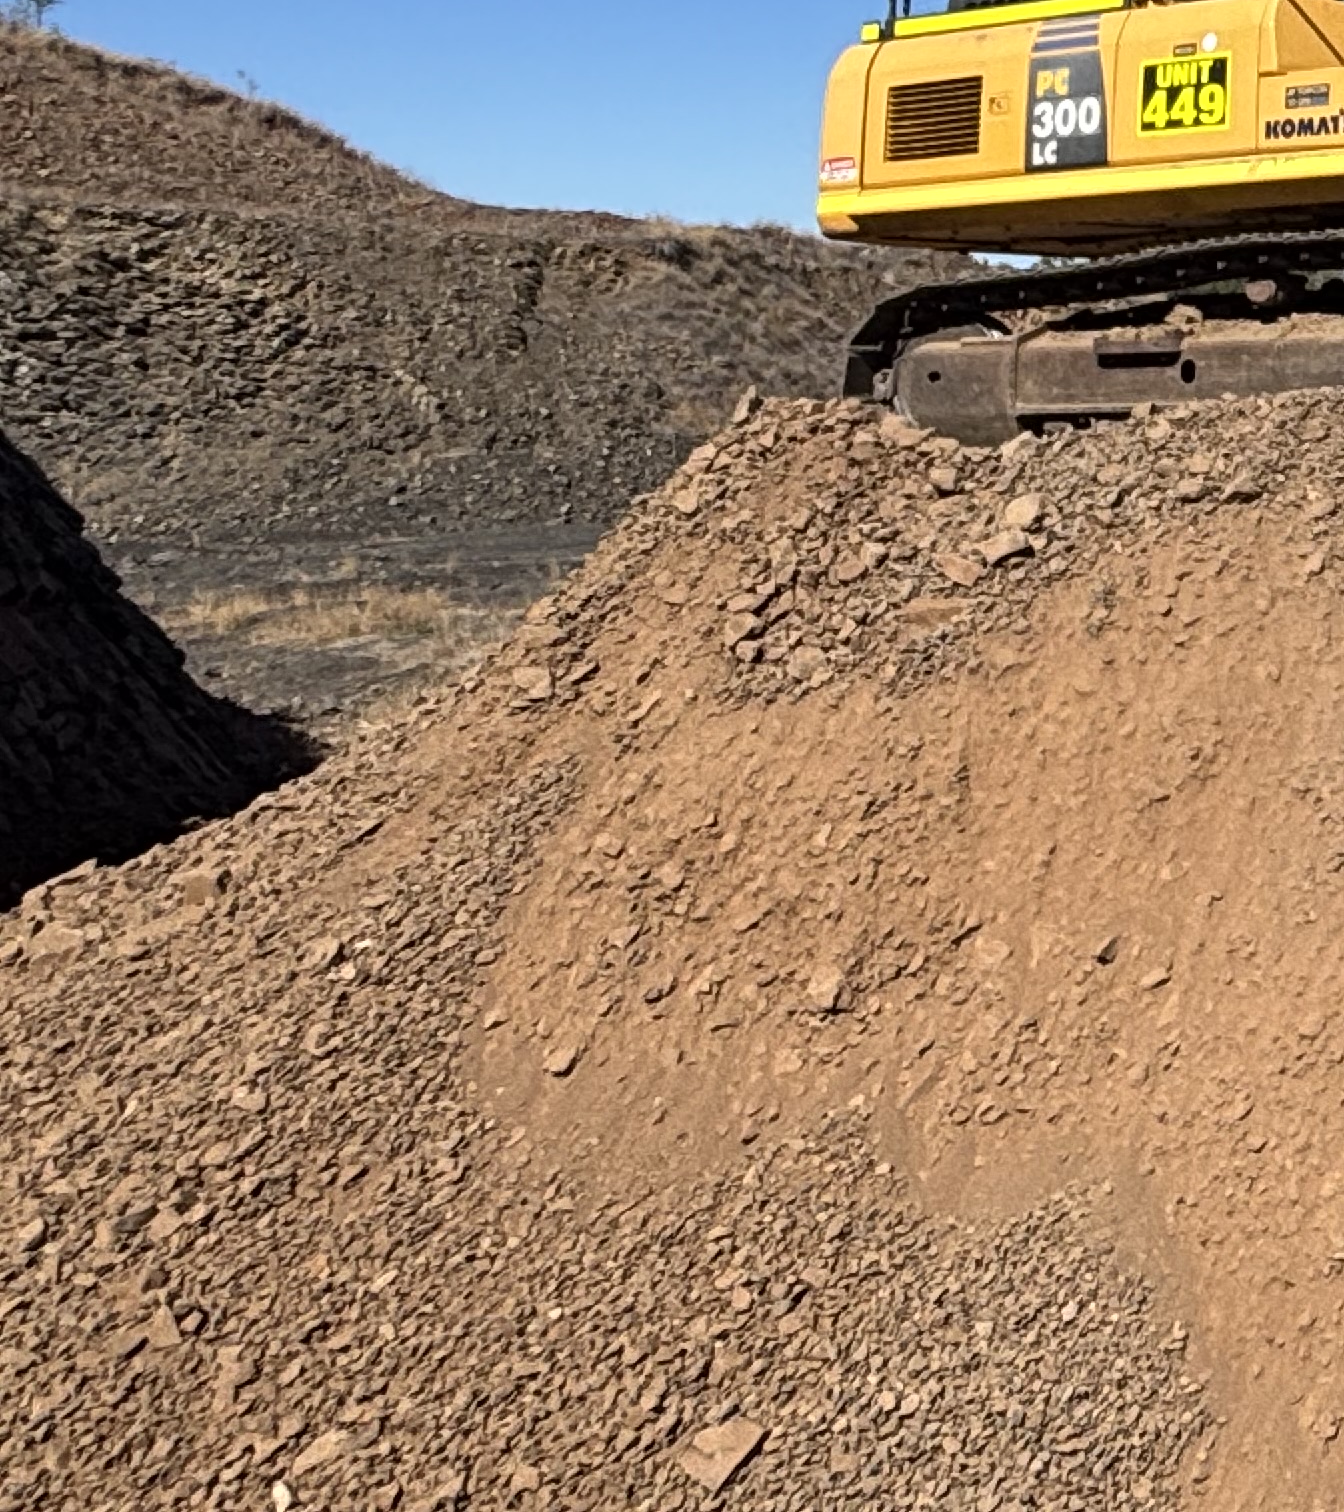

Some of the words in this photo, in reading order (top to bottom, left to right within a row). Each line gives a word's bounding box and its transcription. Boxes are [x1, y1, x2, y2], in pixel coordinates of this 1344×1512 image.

[1036, 67, 1070, 97] PC
[1156, 60, 1213, 88] UNIT
[1032, 96, 1100, 138] 300
[1143, 83, 1225, 128] 449
[1032, 139, 1058, 166] LC
